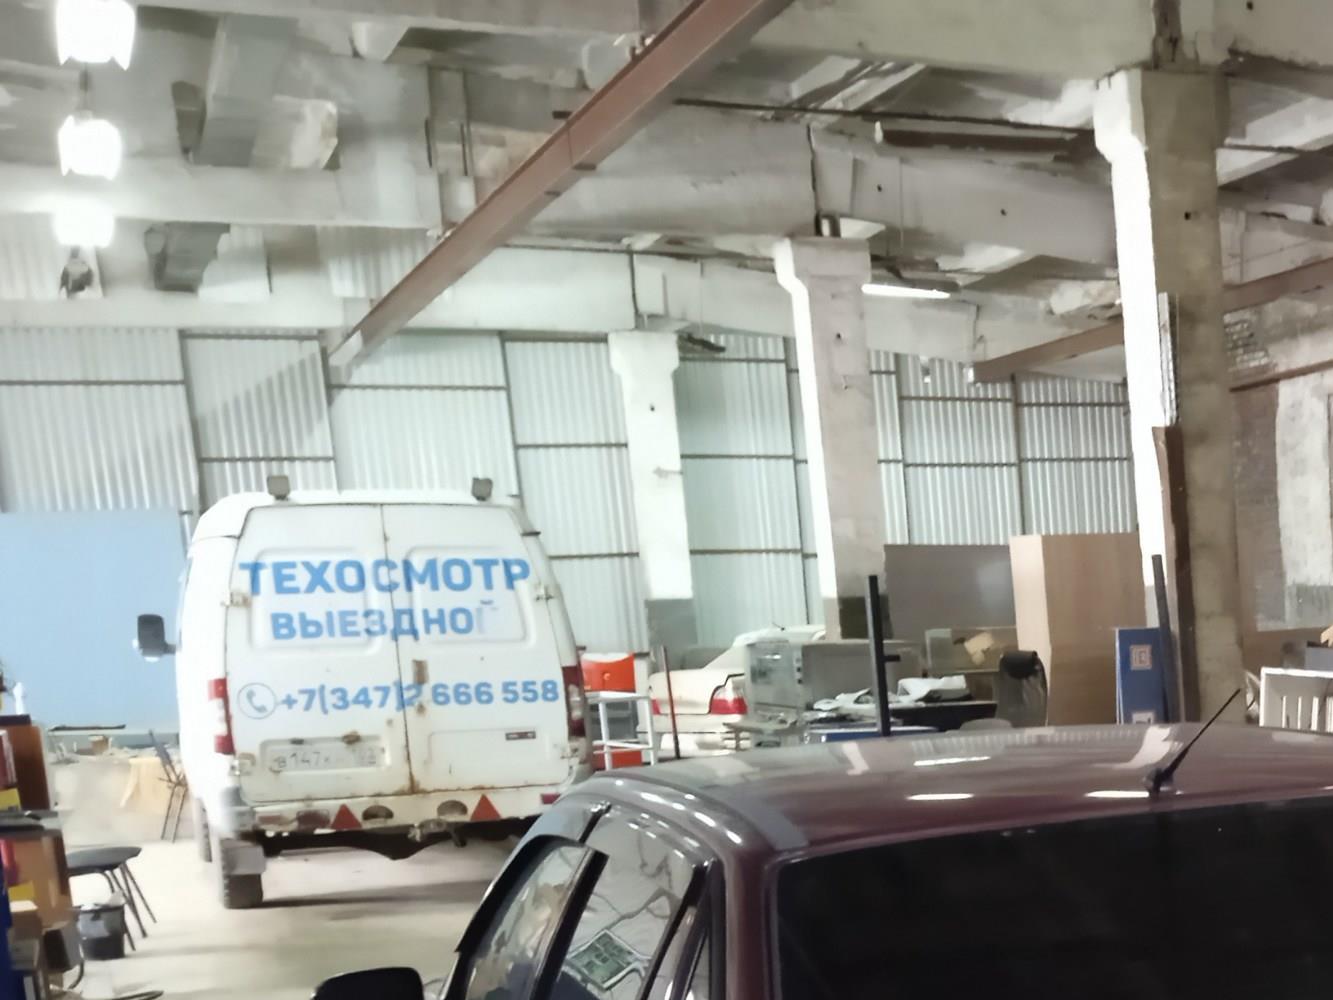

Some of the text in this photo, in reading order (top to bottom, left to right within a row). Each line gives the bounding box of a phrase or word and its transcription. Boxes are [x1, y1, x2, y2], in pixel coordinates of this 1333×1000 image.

[238, 558, 531, 596] ТЕХОСМОТР
[431, 682, 494, 706] 666
[501, 679, 560, 703] 558
